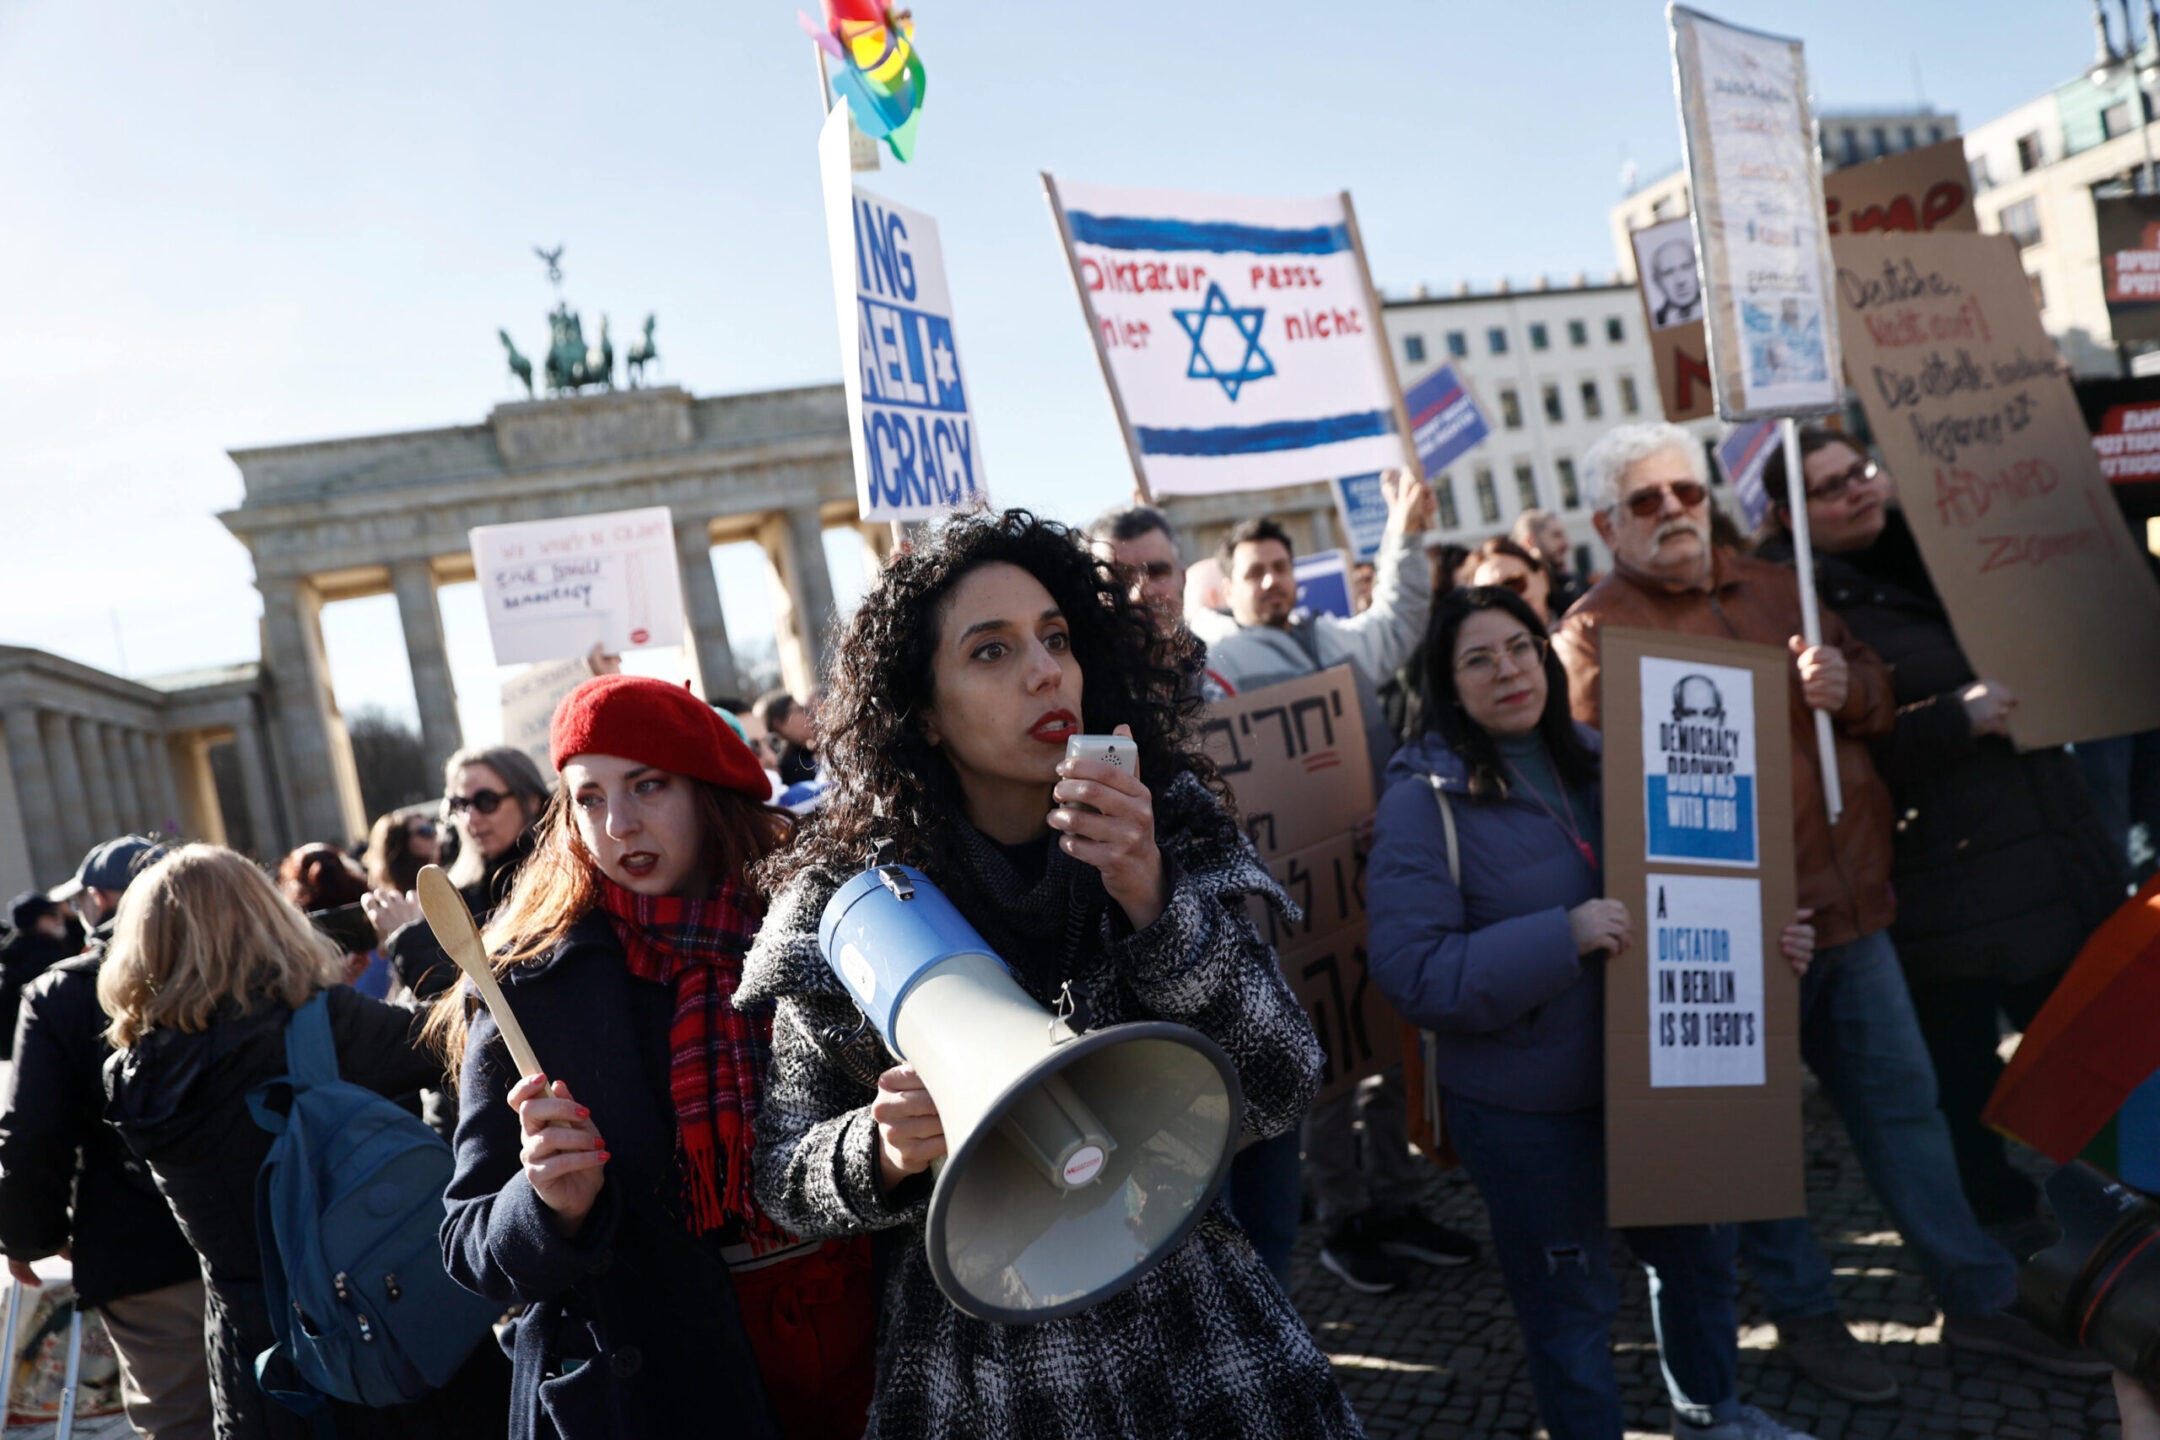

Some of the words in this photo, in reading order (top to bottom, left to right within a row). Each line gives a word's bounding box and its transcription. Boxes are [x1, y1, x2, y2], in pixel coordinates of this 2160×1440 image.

[852, 195, 917, 303] ING
[1081, 256, 1206, 293] Diktatur
[1285, 308, 1363, 341] nicht
[860, 302, 931, 407] AELI
[1660, 722, 1739, 758] DEMOCRACY
[1666, 755, 1737, 798] DROWNS
[1667, 795, 1705, 829] WITH
[1706, 798, 1737, 832] BIBI
[1657, 885, 1668, 919] A
[1658, 926, 1730, 963] DICTATOR
[1659, 970, 1676, 1003] IN
[1682, 970, 1736, 1004] BERLIN
[1660, 1012, 1675, 1046] IS
[1681, 1012, 1700, 1046] SO
[1706, 1012, 1756, 1047] 1930'S
